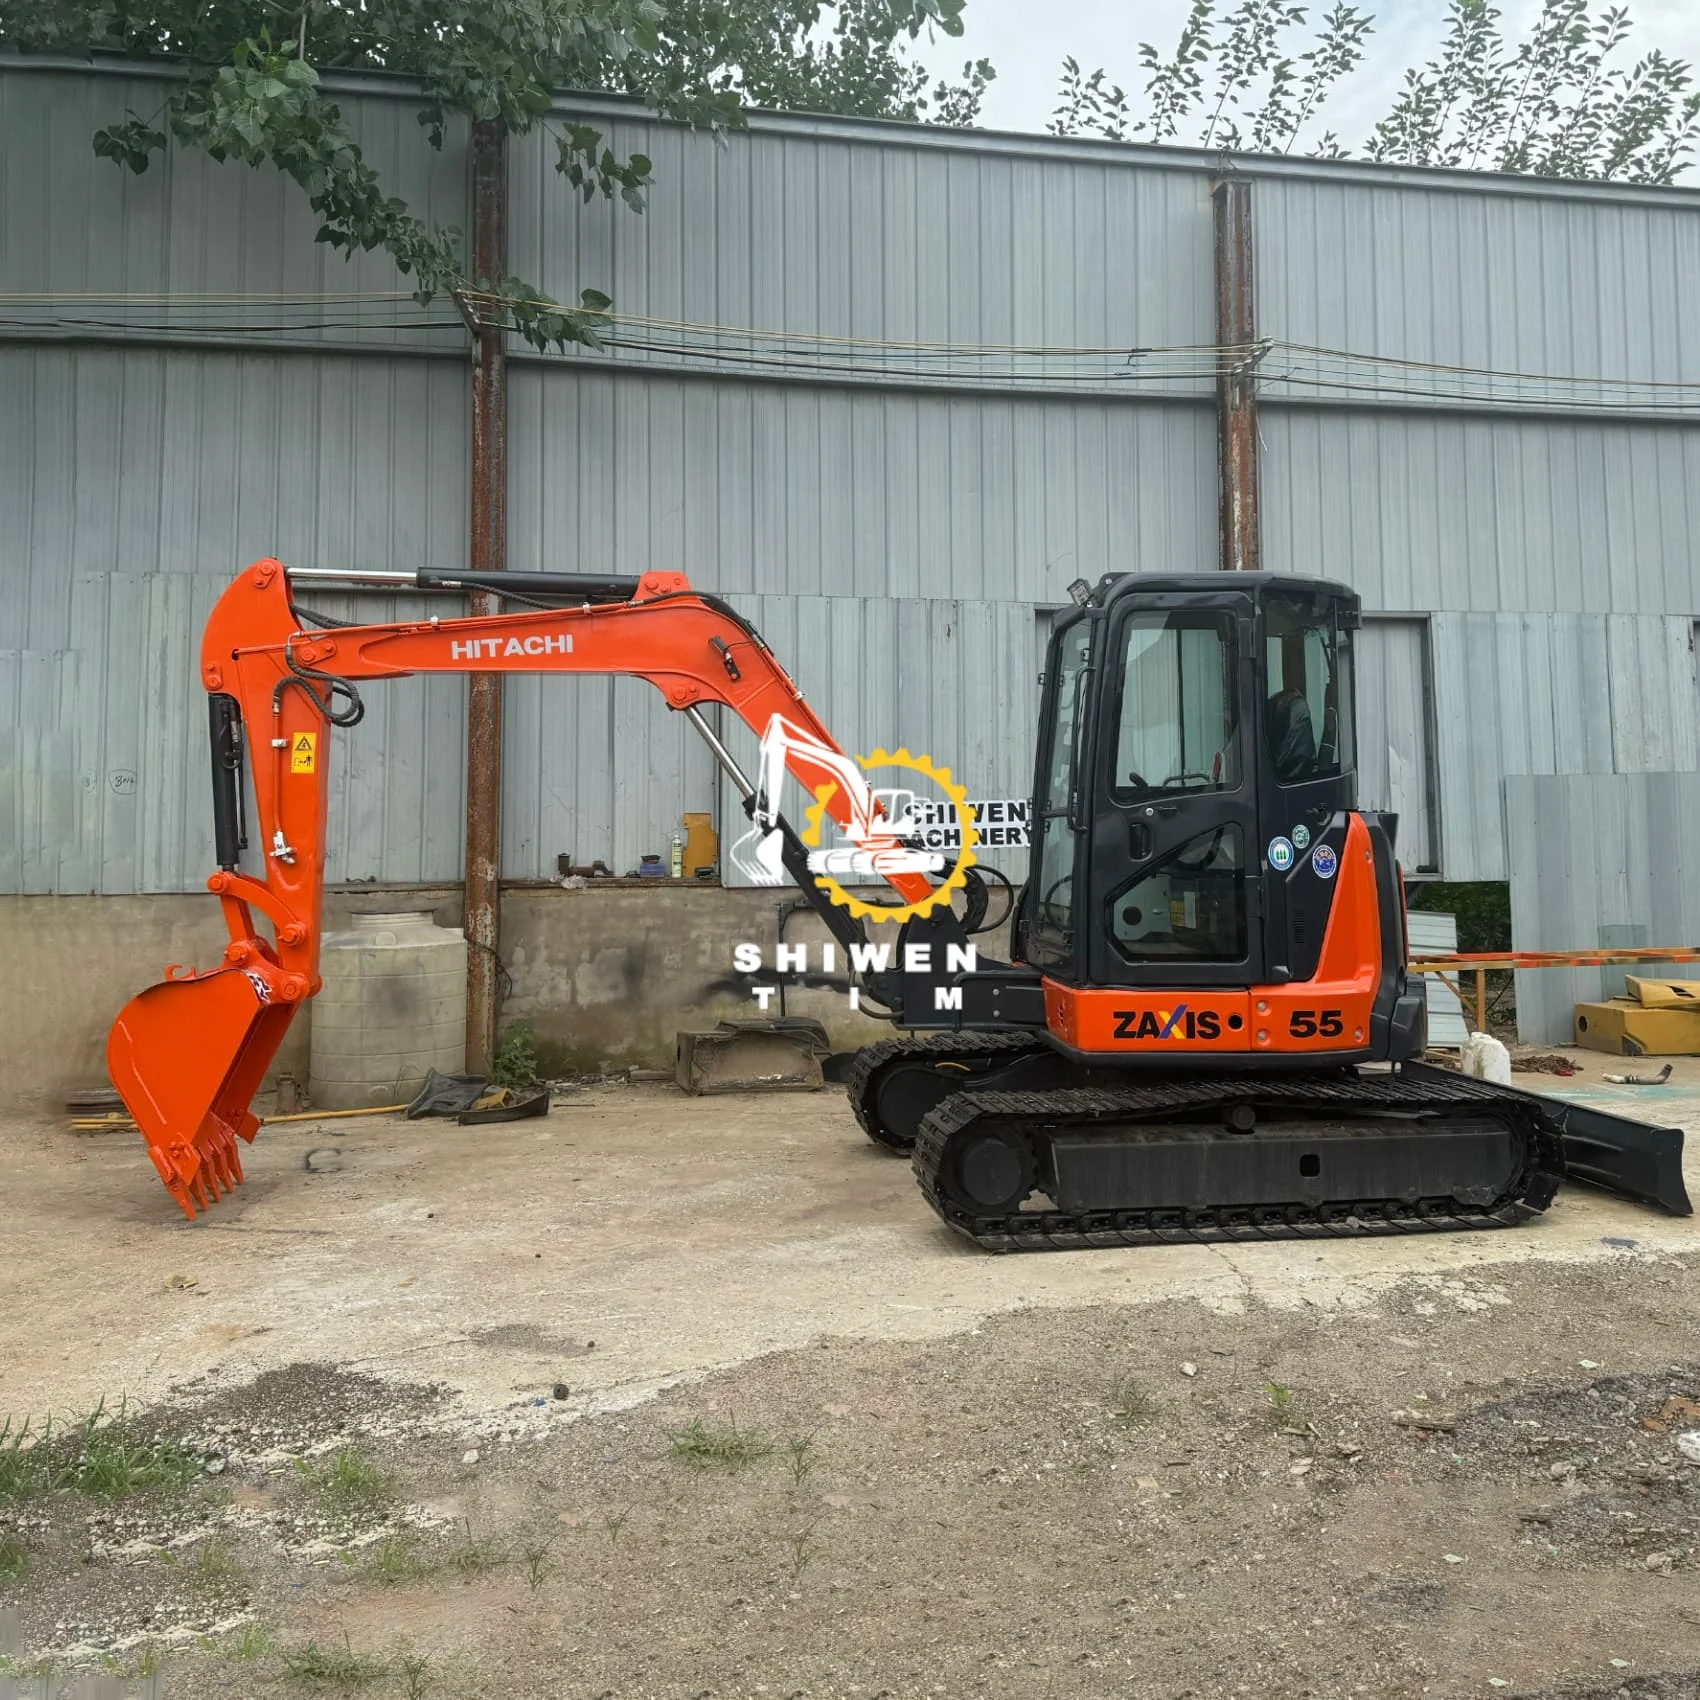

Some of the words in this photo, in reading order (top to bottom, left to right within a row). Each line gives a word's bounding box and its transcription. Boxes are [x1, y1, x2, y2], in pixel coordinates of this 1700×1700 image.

[451, 634, 573, 660] HITACHI
[1113, 1004, 1221, 1040] ZAXIS
[1289, 1010, 1343, 1038] 55
